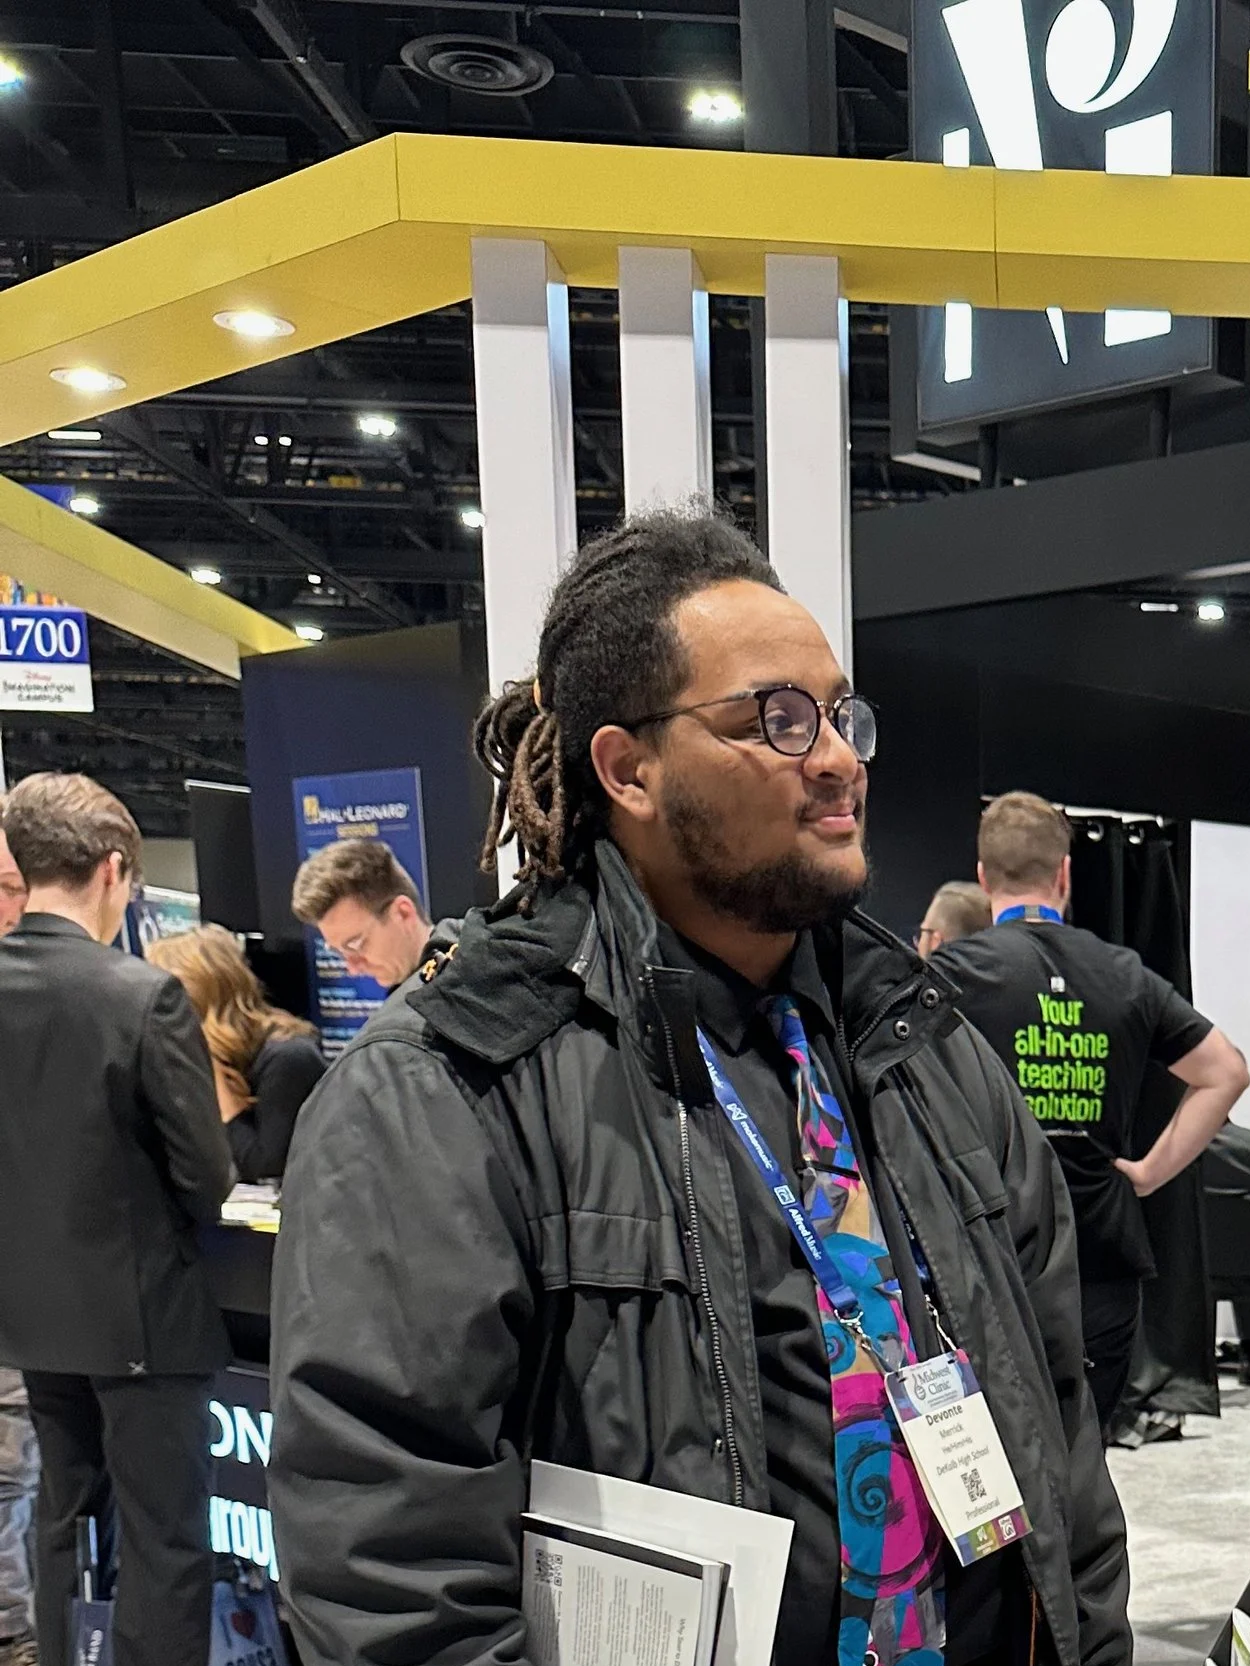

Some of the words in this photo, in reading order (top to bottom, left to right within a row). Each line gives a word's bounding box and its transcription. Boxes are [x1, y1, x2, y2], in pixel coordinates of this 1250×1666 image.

[0, 617, 81, 658] 1700
[1037, 992, 1084, 1025] Your
[1014, 1024, 1109, 1059] all-in-one
[1017, 1060, 1106, 1095] teaching
[788, 1207, 811, 1238] Alfred
[805, 1234, 822, 1261] Music
[928, 1380, 951, 1395] Clinic
[925, 1404, 963, 1426] Devonte
[957, 1453, 972, 1467] High
[971, 1445, 990, 1461] School
[965, 1496, 1001, 1520] Professional
